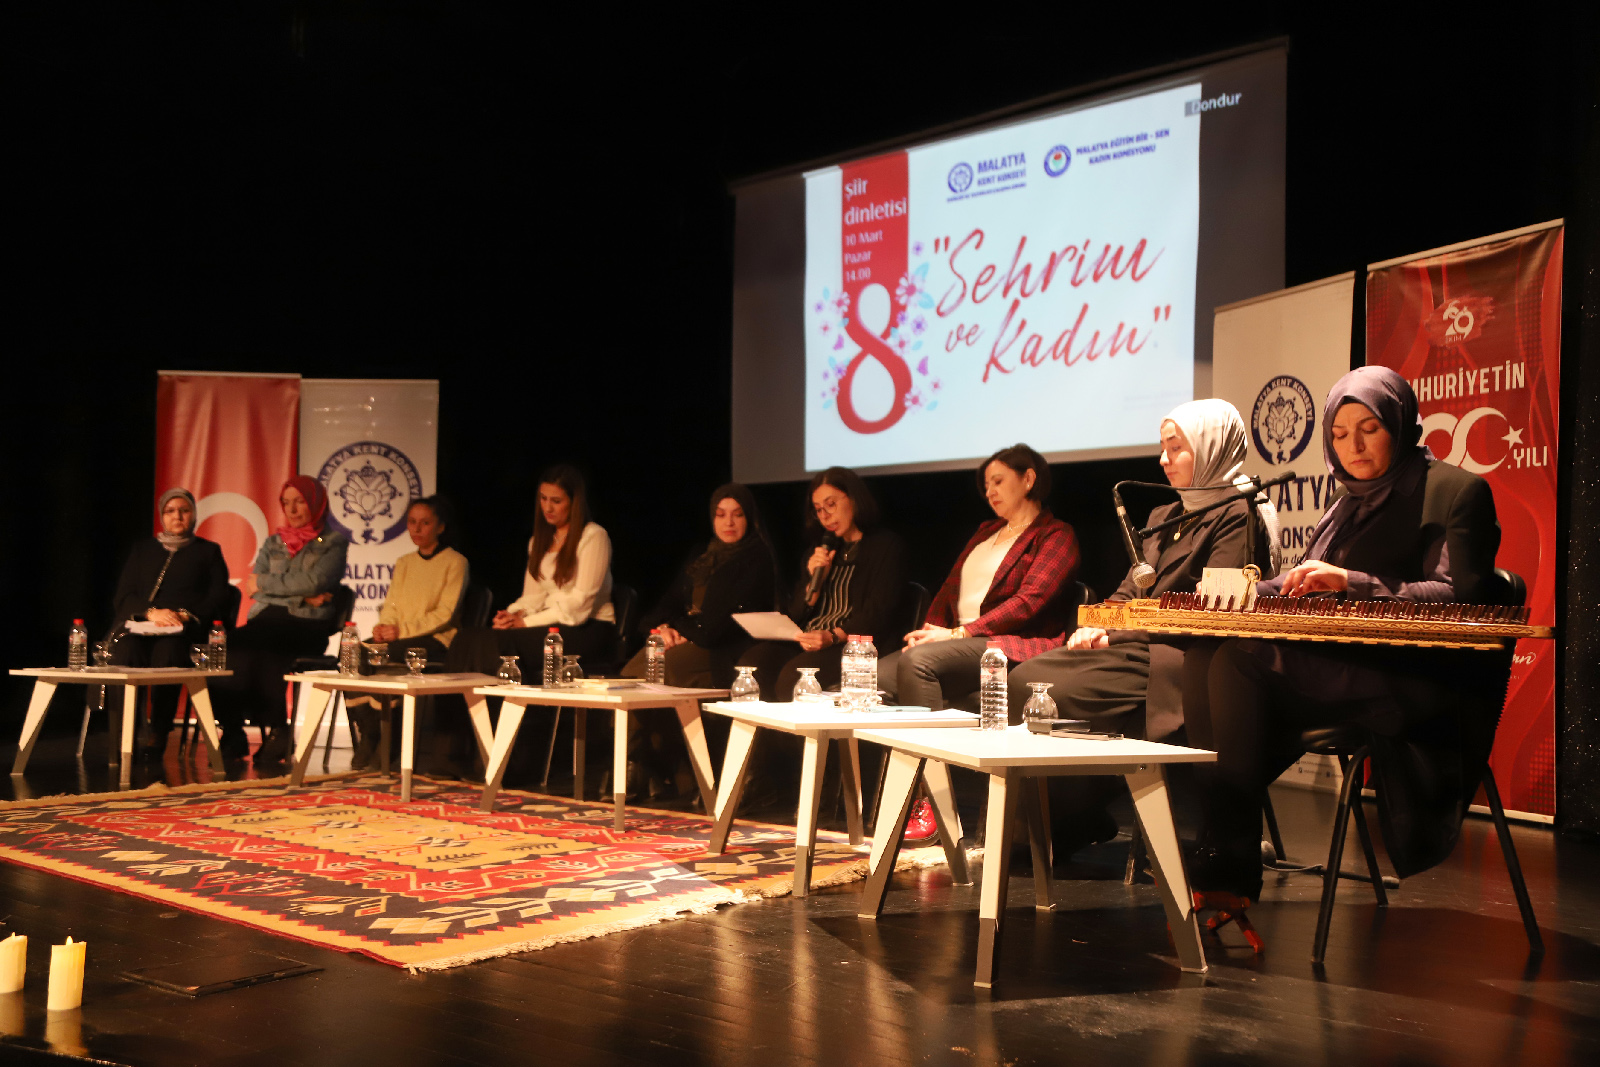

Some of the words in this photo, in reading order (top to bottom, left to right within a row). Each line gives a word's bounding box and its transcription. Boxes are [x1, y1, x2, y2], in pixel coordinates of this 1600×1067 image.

[1192, 93, 1242, 114] Dondur
[977, 152, 1026, 174] MALATYA
[977, 175, 996, 187] KENT
[844, 197, 907, 225] dinletisi
[846, 234, 857, 247] 10
[859, 230, 883, 244] Mart
[845, 251, 872, 265] Pazar
[846, 267, 872, 283] 14.00
[945, 323, 985, 353] ve
[1271, 378, 1293, 389] KENT
[1407, 360, 1525, 402] MHURİYETİN
[353, 445, 390, 456] KENT
[1275, 475, 1337, 512] ATYA
[344, 563, 396, 580] ALATY
